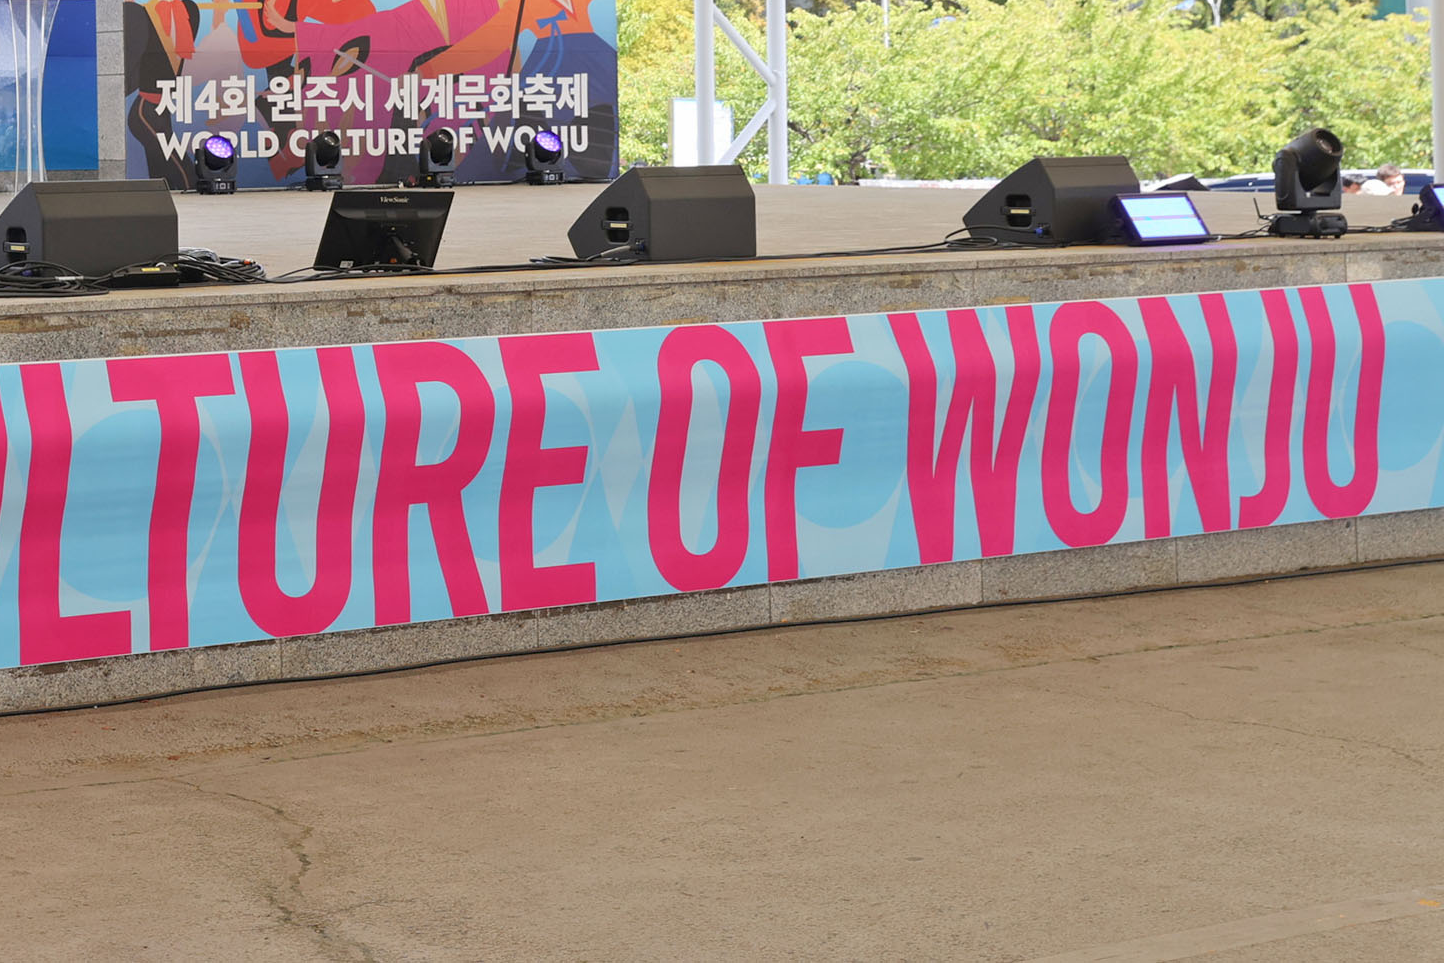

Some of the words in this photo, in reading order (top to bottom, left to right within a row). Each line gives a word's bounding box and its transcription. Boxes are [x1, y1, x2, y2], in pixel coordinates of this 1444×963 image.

[155, 74, 256, 124] 제4회
[266, 74, 374, 122] 원주시
[384, 73, 589, 120] 세계문화축제
[289, 127, 424, 158] CTURE
[482, 125, 589, 159] WOJU
[647, 316, 854, 593] OF
[886, 283, 1386, 565] WONJU
